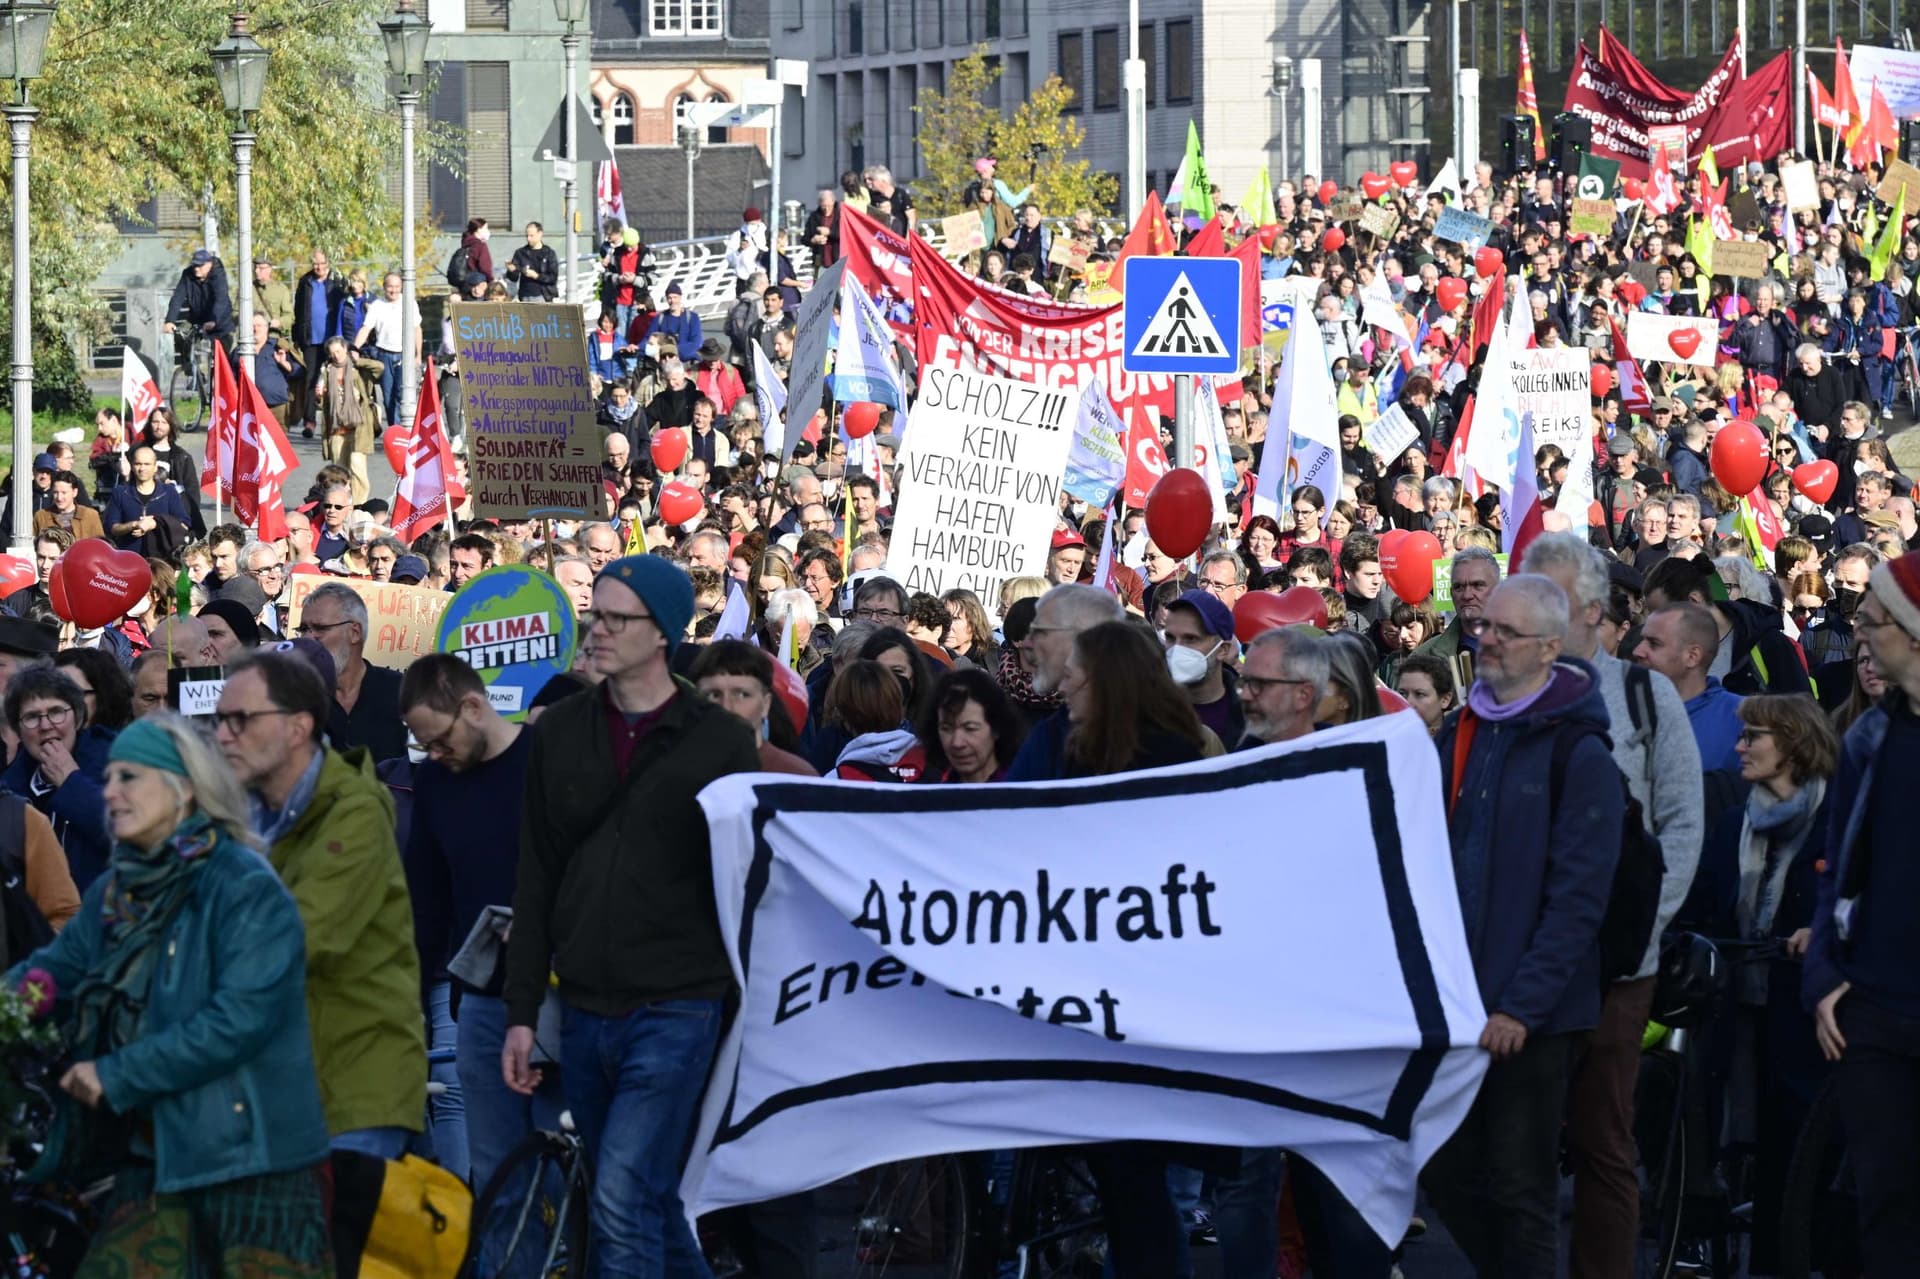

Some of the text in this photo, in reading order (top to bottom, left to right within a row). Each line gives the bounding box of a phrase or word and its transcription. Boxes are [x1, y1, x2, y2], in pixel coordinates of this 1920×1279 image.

[458, 313, 572, 345] Schluß mit:
[982, 330, 1013, 355] DER
[1020, 310, 1122, 361] KRISE
[475, 367, 530, 388] imperialer
[925, 368, 1067, 432] SCHOLZ!!!
[480, 412, 575, 441] Aufrüstung!
[476, 436, 567, 459] SOLIDARITÄT
[961, 423, 1018, 464] KEIN
[476, 460, 604, 485] FRIEDEN SCHAFFEN
[910, 450, 1060, 507] VERKAUF VON
[480, 484, 518, 507] durch
[934, 494, 1015, 537] HAFEN
[911, 526, 1025, 574] HAMBURG
[88, 579, 129, 598] hochhalten!
[95, 570, 129, 588] Solidarität
[904, 564, 1004, 609] AN CHI
[464, 614, 546, 647] KLIMA
[490, 693, 514, 702] BUND
[850, 863, 1222, 946] Atomkraft
